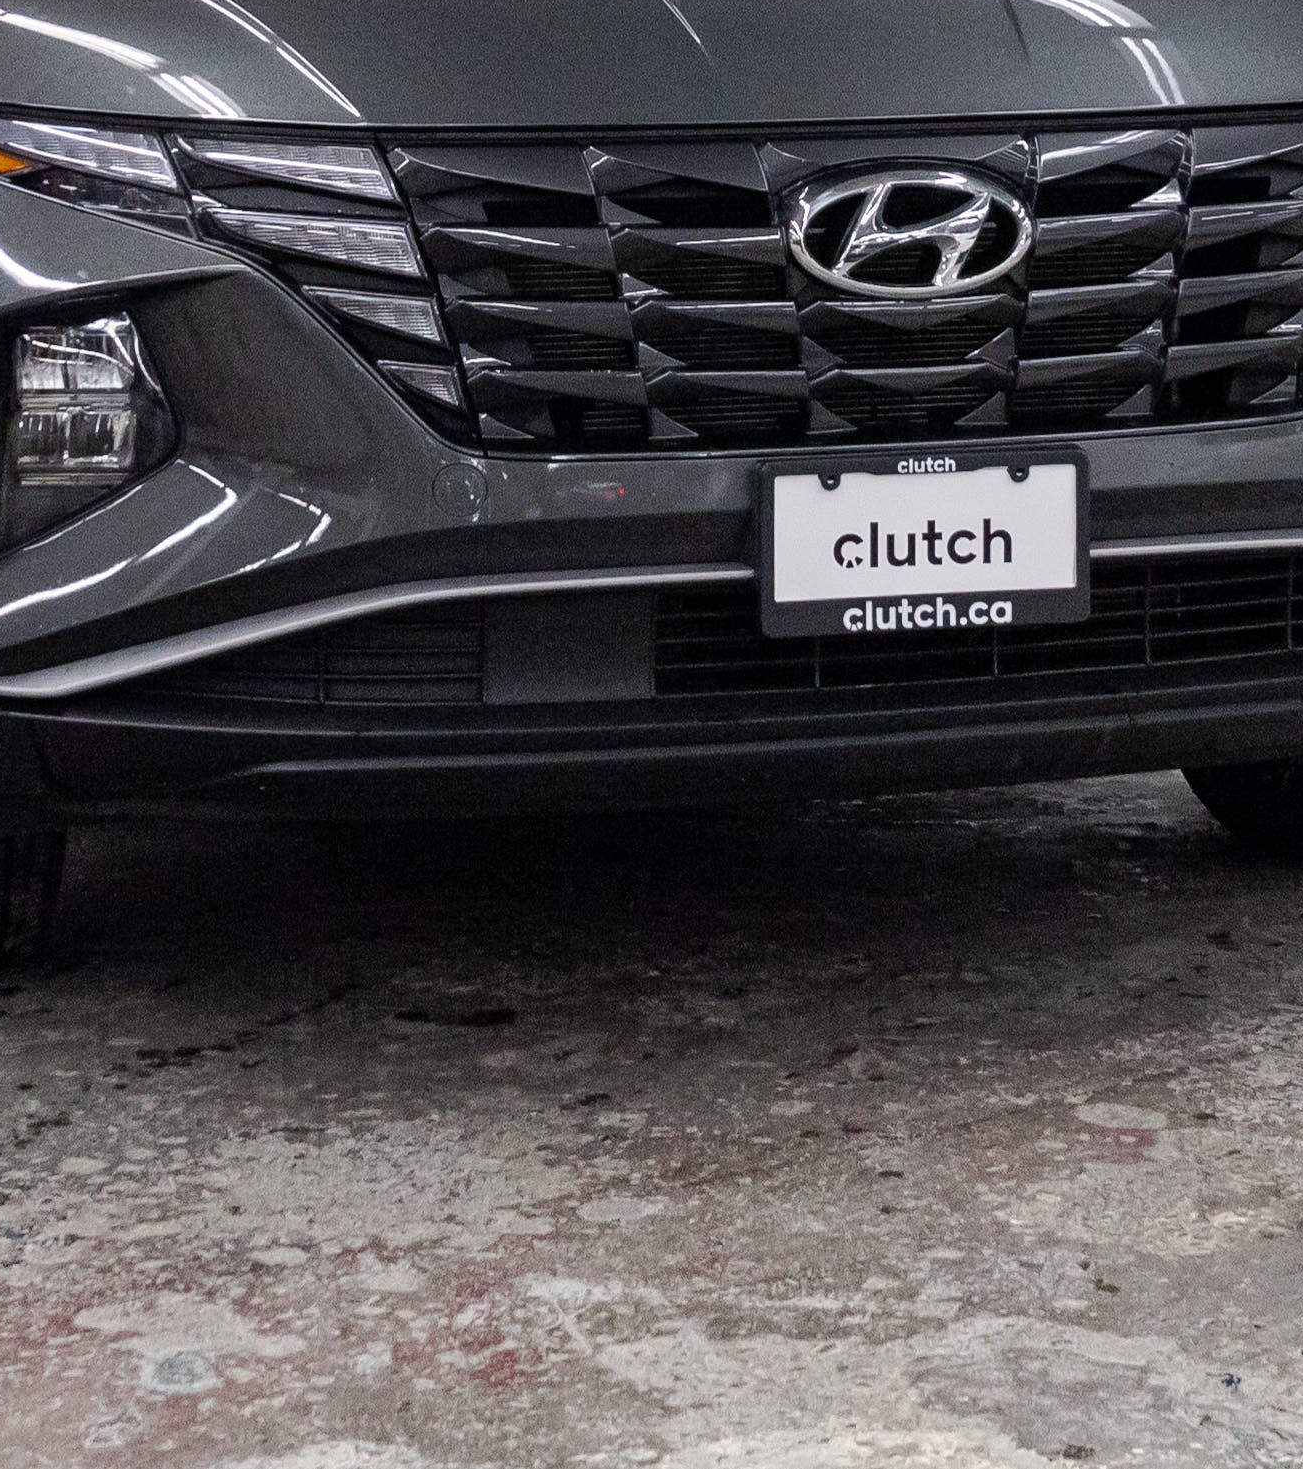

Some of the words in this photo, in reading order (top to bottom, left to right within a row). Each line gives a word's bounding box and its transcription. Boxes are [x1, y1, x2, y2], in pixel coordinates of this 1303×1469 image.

[897, 456, 957, 475] clutch
[833, 518, 1013, 569] clutch
[842, 597, 1013, 632] clutch.ca
